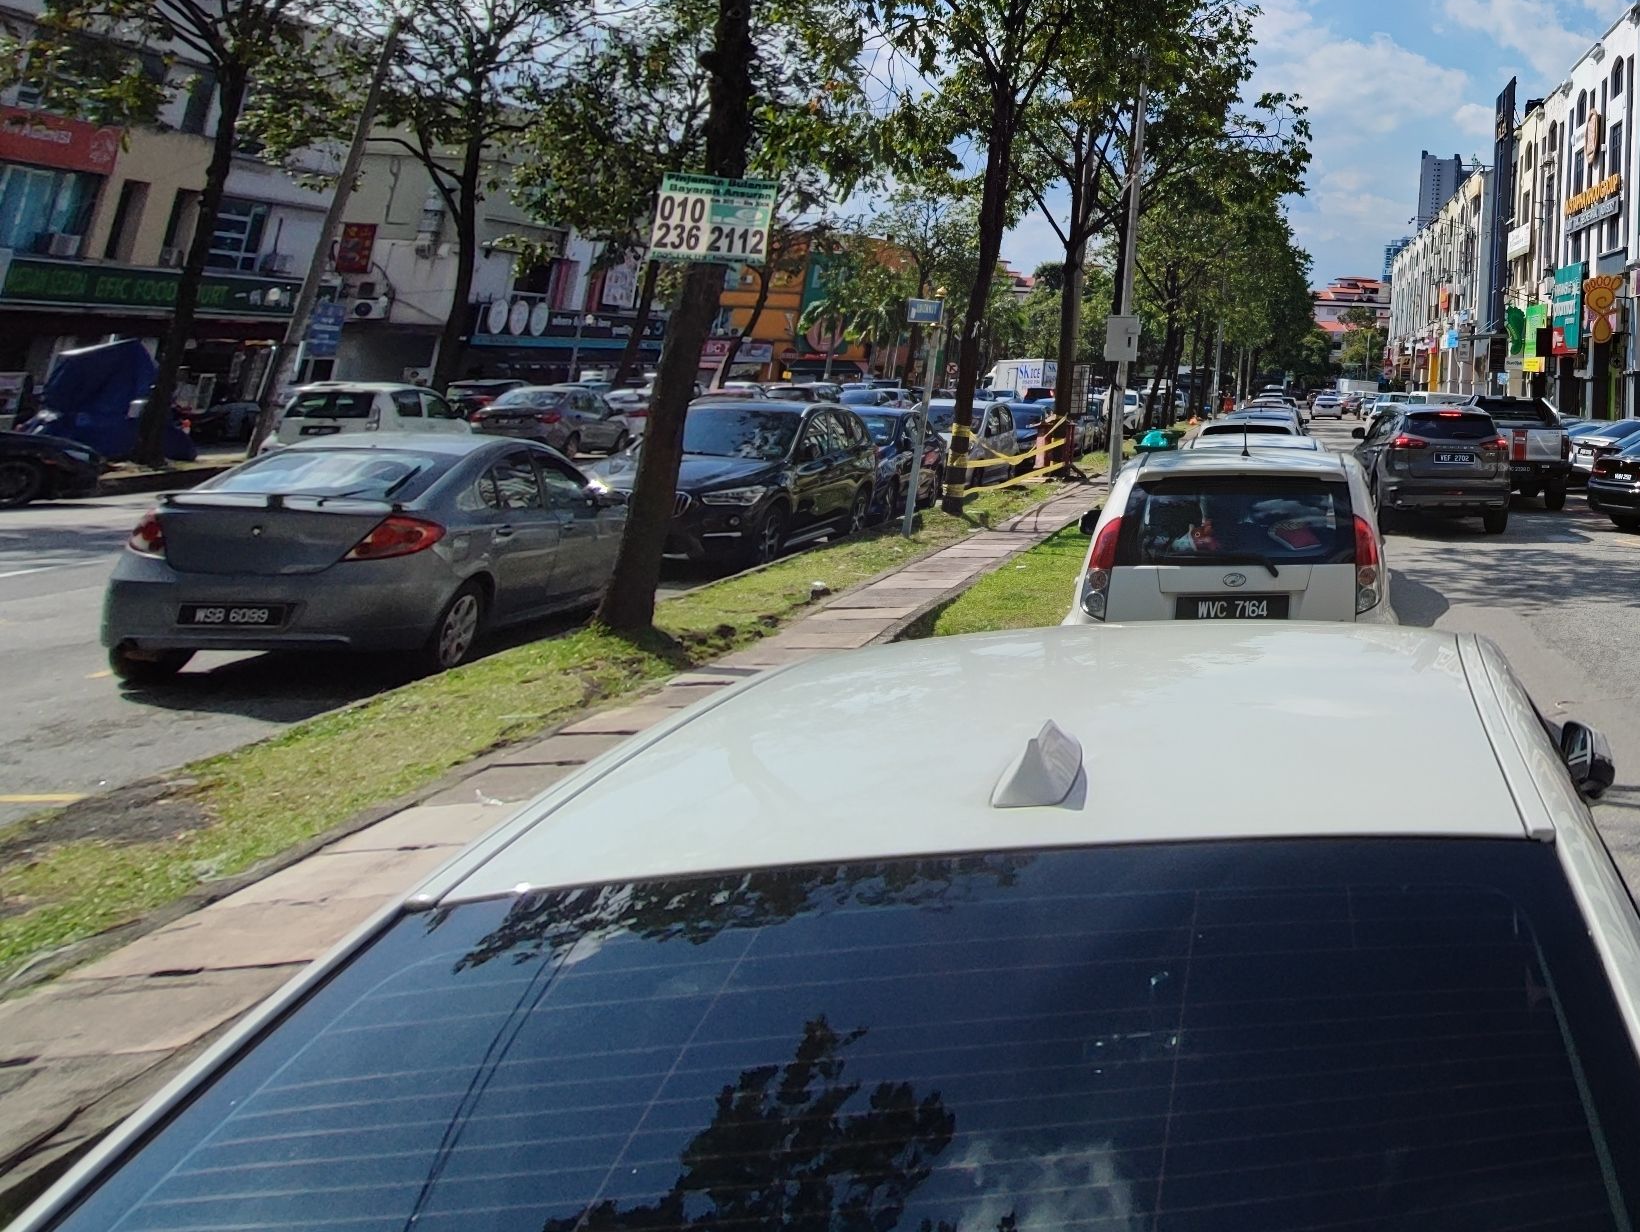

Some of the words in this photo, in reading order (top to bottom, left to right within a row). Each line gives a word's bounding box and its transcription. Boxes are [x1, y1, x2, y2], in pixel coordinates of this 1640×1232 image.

[667, 174, 724, 185] Pinjaman
[728, 179, 776, 190] Bulanan
[669, 184, 719, 195] Bayaran
[721, 189, 771, 199] Ansuran
[660, 195, 705, 223] 010
[653, 223, 701, 250] 236
[706, 226, 764, 254] 2112
[1198, 601, 1227, 618] WVC
[1234, 600, 1267, 618] 7164
